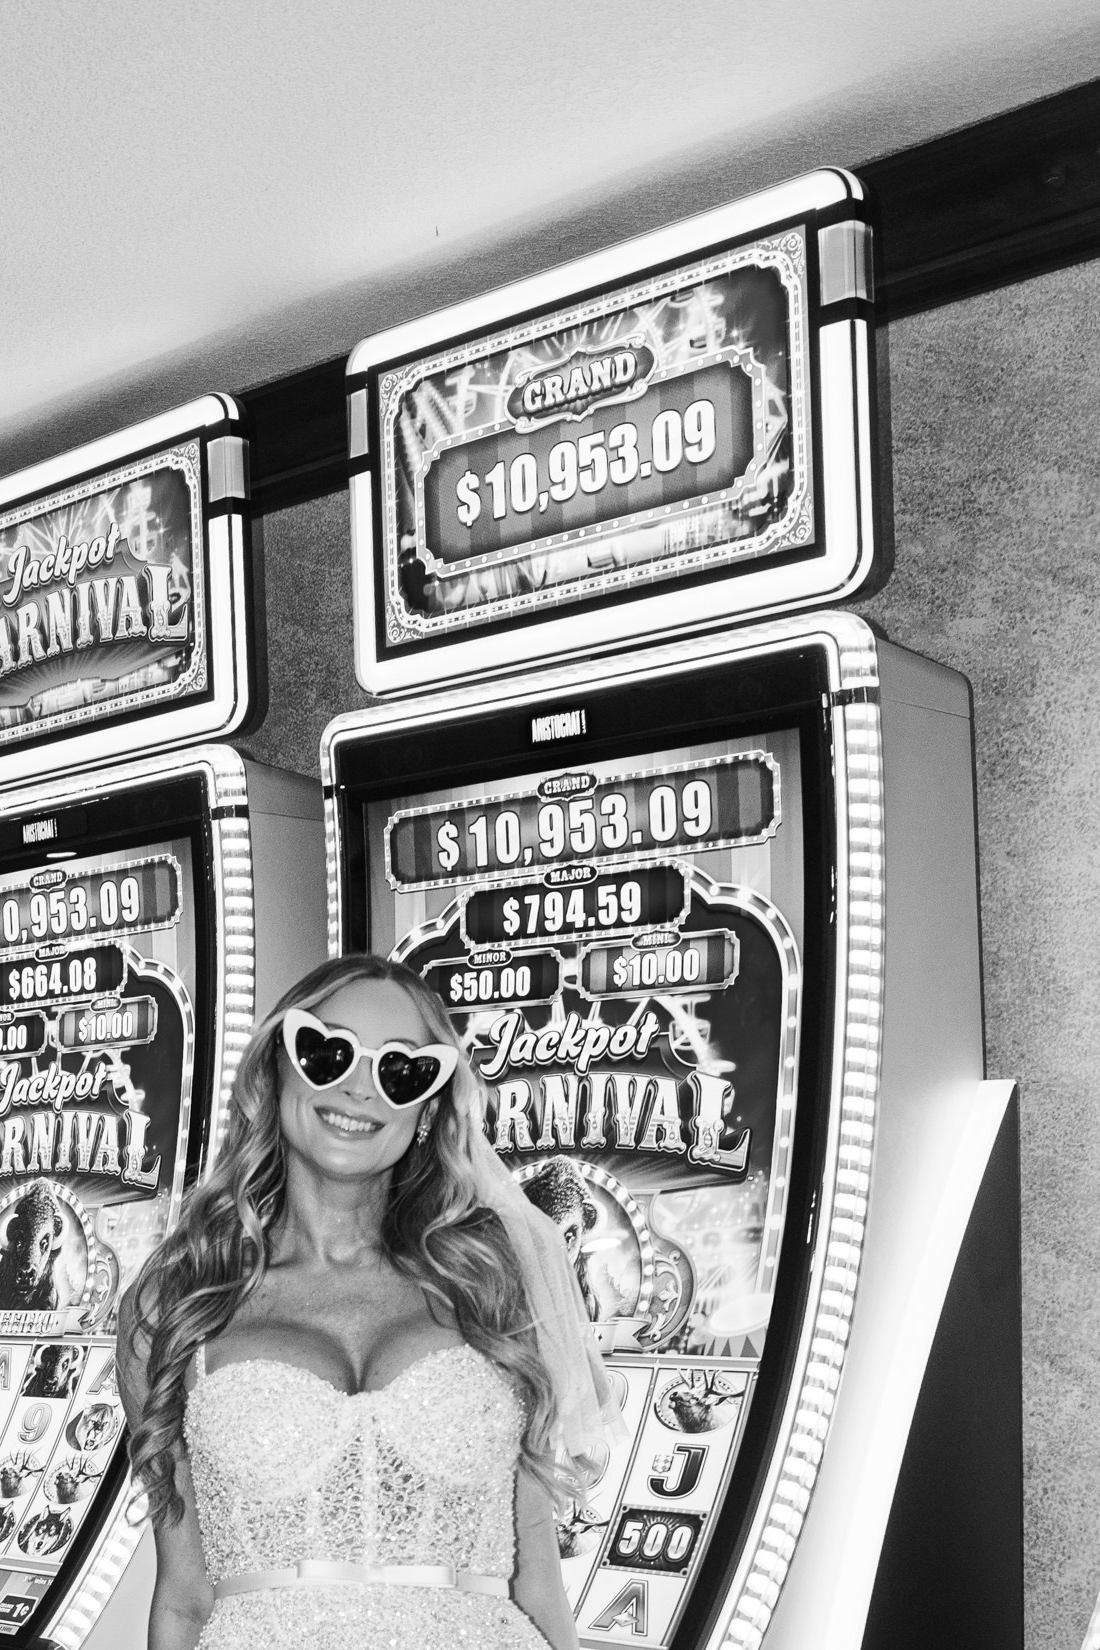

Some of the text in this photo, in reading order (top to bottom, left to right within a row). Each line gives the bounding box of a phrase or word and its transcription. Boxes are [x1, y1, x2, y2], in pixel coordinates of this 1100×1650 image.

[522, 351, 638, 413] GRAND
[456, 399, 717, 527] $10,953.09
[3, 522, 121, 605] Jackpot
[543, 775, 591, 795] GRAND
[437, 779, 712, 873] $10,953.09
[32, 871, 64, 887] GRAND
[550, 866, 592, 883] MAJOR
[503, 881, 642, 936] $794.59
[38, 945, 66, 958] MAJOR
[473, 949, 507, 965] MINOR
[642, 932, 670, 946] MINI
[8, 956, 97, 1000] $664.08
[449, 965, 531, 1002] $50.00
[612, 947, 700, 989] $10.00
[78, 1011, 133, 1043] $10.00
[479, 1010, 659, 1080] Jackpot
[485, 1071, 753, 1173] RNIVAL
[86, 1350, 120, 1396] A
[18, 1402, 53, 1445] 9
[648, 1442, 710, 1500] J
[618, 1518, 694, 1563] 500
[12, 1602, 30, 1618] 1¢
[588, 1578, 649, 1637] A
